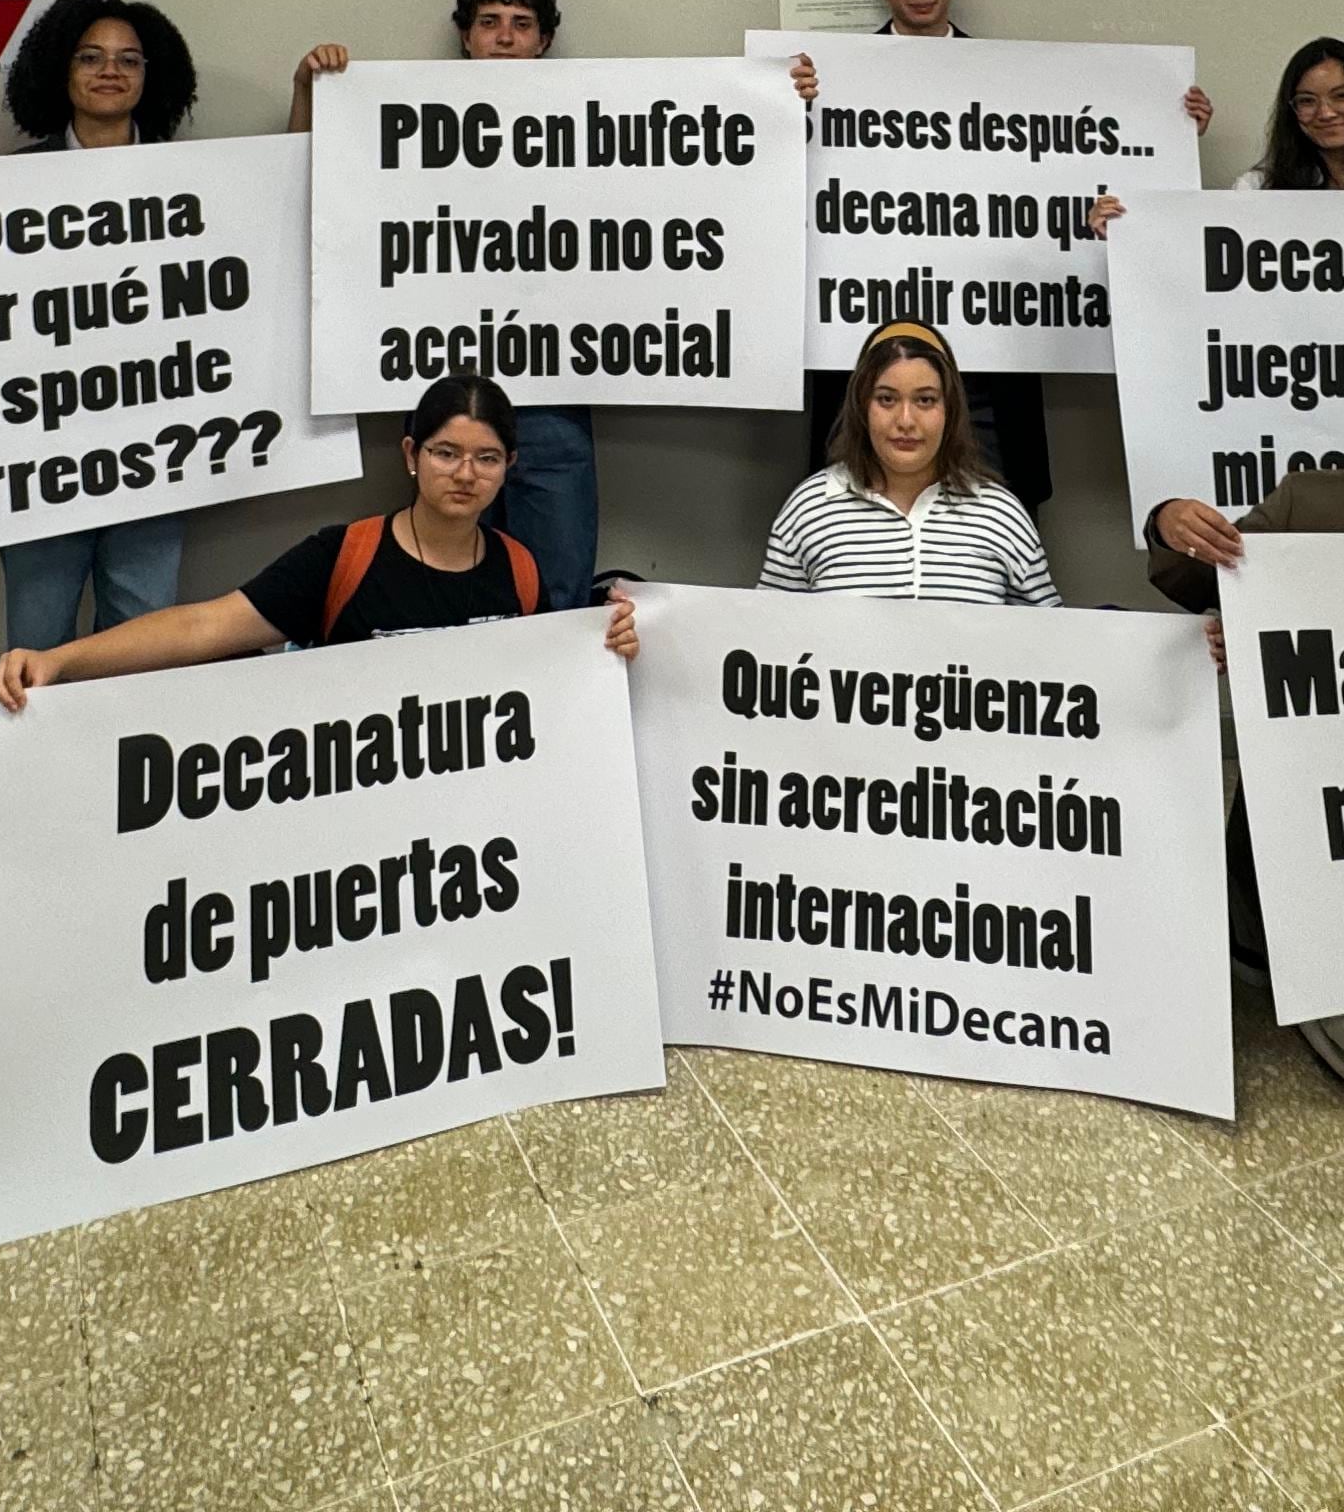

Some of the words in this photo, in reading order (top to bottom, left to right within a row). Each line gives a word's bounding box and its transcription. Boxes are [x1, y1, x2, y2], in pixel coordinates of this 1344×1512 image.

[380, 102, 503, 169] PDG
[512, 114, 575, 167] en
[586, 99, 755, 166] bufete
[821, 106, 951, 149] meses
[959, 101, 1155, 162] después...
[380, 204, 579, 288] privado
[590, 218, 652, 272] no
[663, 217, 724, 271] es
[815, 178, 979, 237] decana
[989, 196, 1039, 238] no
[1047, 185, 1107, 251] qu
[33, 267, 149, 347] qué
[161, 256, 250, 320] NO
[819, 267, 953, 325] rendir
[962, 276, 1111, 328] cuenta
[380, 308, 559, 381] acción
[570, 307, 731, 378] social
[1212, 435, 1276, 507] mi
[722, 649, 820, 721] Qué
[830, 664, 1100, 742] vergüenza
[118, 690, 536, 834] Decanatura
[691, 751, 768, 826] sin
[779, 766, 1122, 857] acreditación
[144, 877, 235, 984] de
[250, 837, 520, 983] puertas
[725, 862, 1093, 974] internacional
[708, 969, 1111, 1055] #NoEsMiDecana
[89, 957, 575, 1165] CERRADAS!
